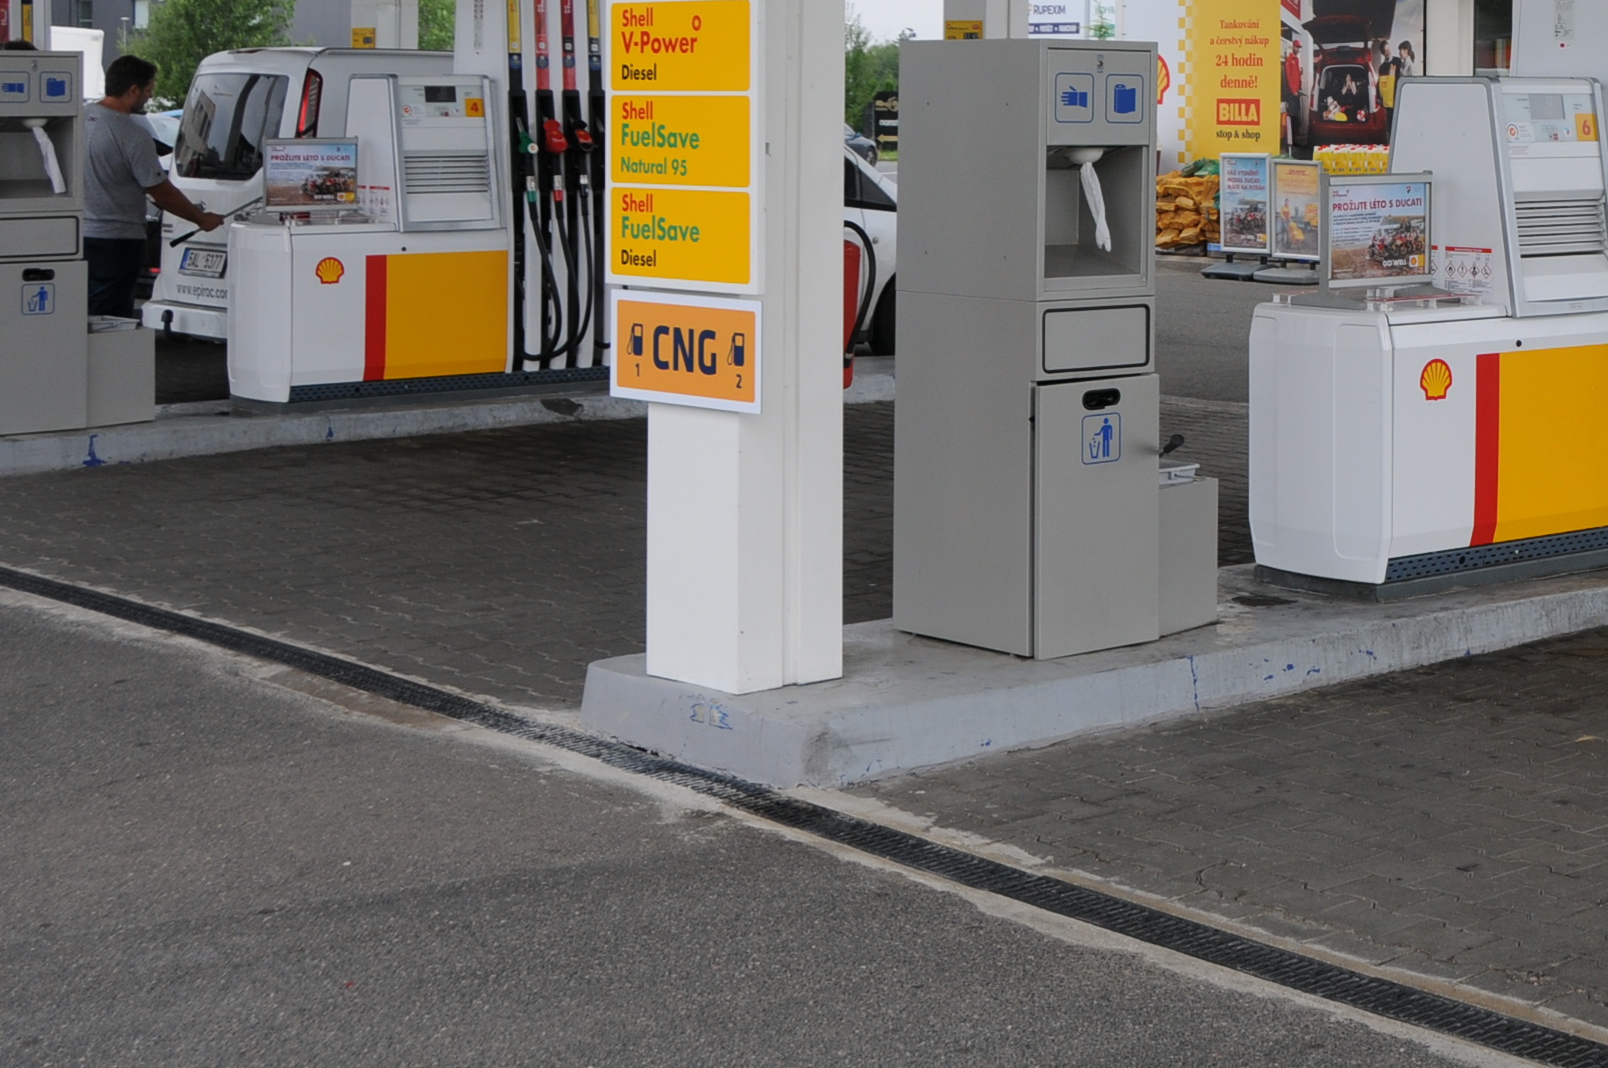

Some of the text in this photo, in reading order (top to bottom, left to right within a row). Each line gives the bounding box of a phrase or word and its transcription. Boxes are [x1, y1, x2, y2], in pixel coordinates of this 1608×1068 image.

[622, 7, 654, 28] Shell
[1219, 19, 1259, 29] Tankování
[621, 31, 698, 54] V-Power
[1216, 35, 1243, 47] čerstvý
[1245, 35, 1269, 47] nákup
[1215, 53, 1263, 66] 24 hodin
[622, 63, 657, 80] Diesel
[1220, 75, 1258, 88] denně!
[470, 102, 479, 113] 4
[622, 101, 654, 120] Shell
[1219, 103, 1258, 122] BILLA
[621, 122, 700, 149] FuelSave
[1216, 129, 1260, 142] stop & shop
[1582, 119, 1591, 136] 6
[621, 157, 688, 176] Natural 95
[622, 193, 654, 213] Shell
[1332, 198, 1422, 211] PROŽIJTE LÉTO S DUCATI
[621, 215, 700, 242] FuelSave
[621, 249, 657, 267] Diesel
[653, 325, 717, 375] CNG
[635, 363, 641, 377] 1
[736, 374, 742, 388] 2
